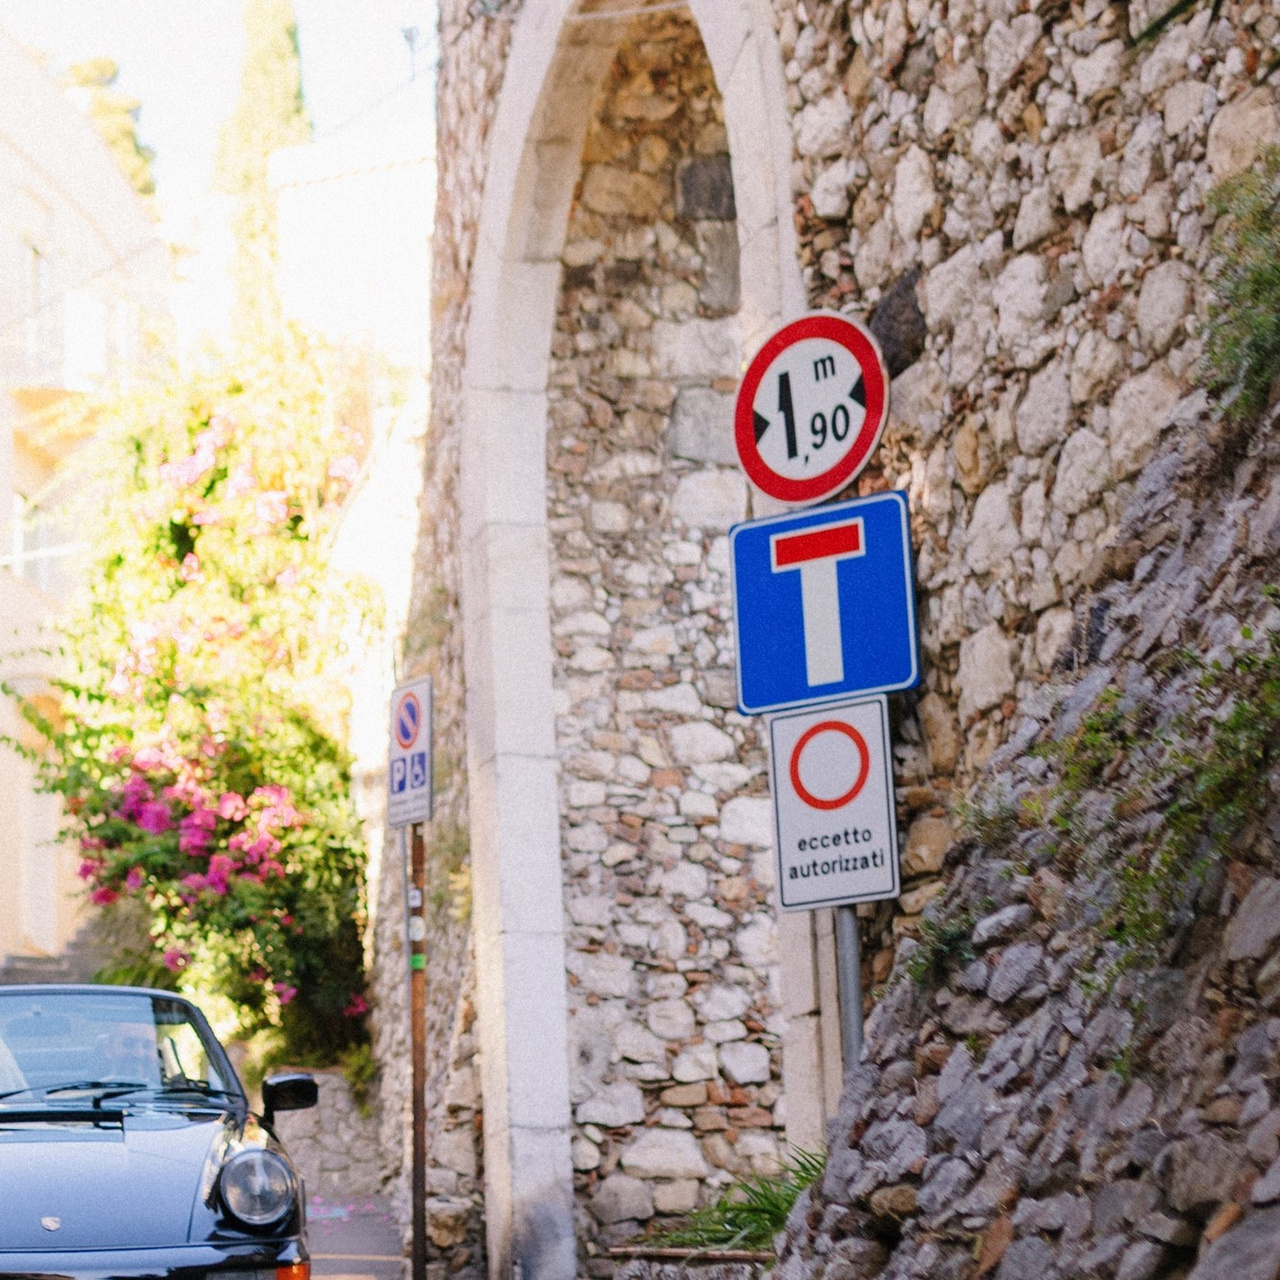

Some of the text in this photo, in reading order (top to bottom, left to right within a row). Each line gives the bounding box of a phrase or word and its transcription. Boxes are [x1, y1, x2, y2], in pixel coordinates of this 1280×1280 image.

[813, 355, 835, 381] m
[798, 827, 872, 851] eccetto
[789, 848, 885, 880] autorizzati
